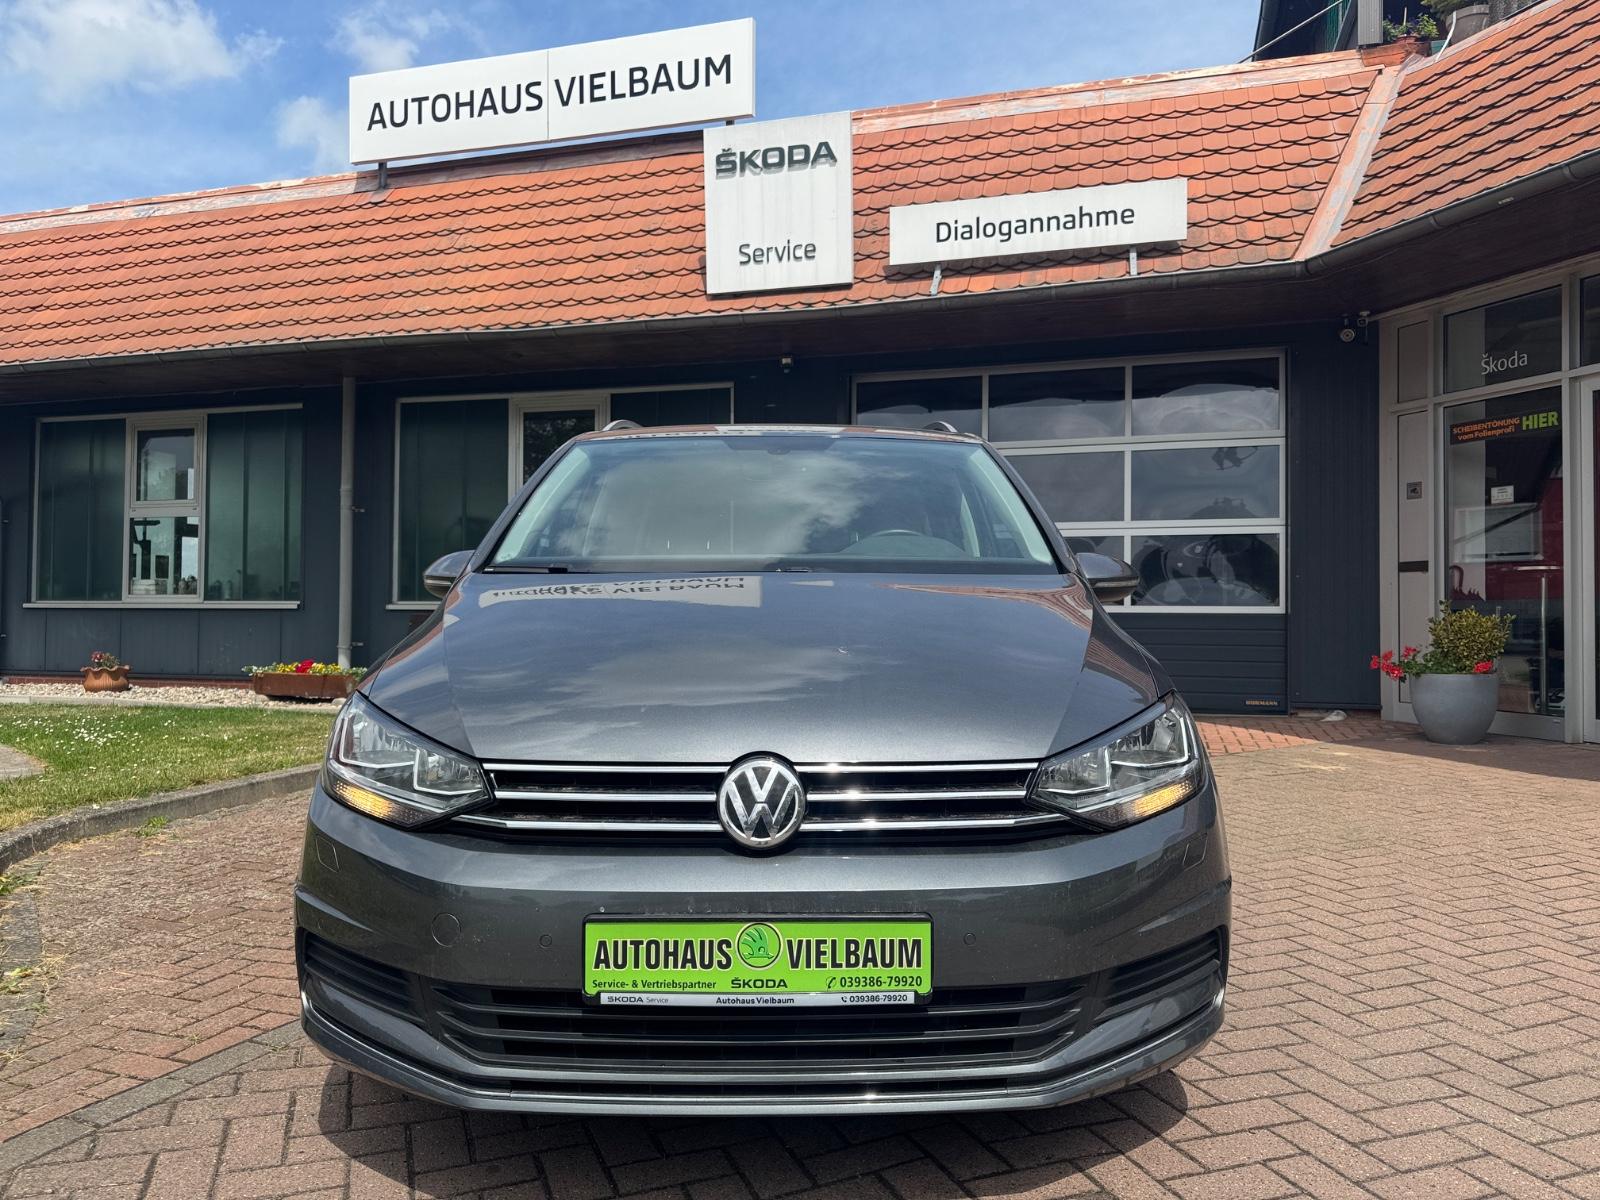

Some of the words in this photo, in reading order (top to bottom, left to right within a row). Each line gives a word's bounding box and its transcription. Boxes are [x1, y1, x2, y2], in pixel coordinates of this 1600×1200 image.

[366, 80, 543, 132] AUTOHAUS
[553, 53, 732, 108] VIELBAUM
[715, 140, 838, 178] ŠKODA
[935, 205, 1136, 244] Dialogannahme
[738, 238, 817, 267] Service
[1481, 350, 1528, 375] Škoda
[1457, 433, 1474, 441] vom
[1474, 425, 1516, 438] Folienprofi
[1522, 411, 1559, 431] HIER
[592, 938, 733, 971] AUTOHAUS
[786, 937, 923, 970] VIELBAUM
[592, 979, 629, 989] Service-
[631, 980, 639, 988] &
[641, 979, 717, 991] Vertriebspartner
[731, 977, 788, 989] ŠKODA
[839, 975, 923, 988] 039386-79920
[849, 994, 908, 1003] 039386-79920
